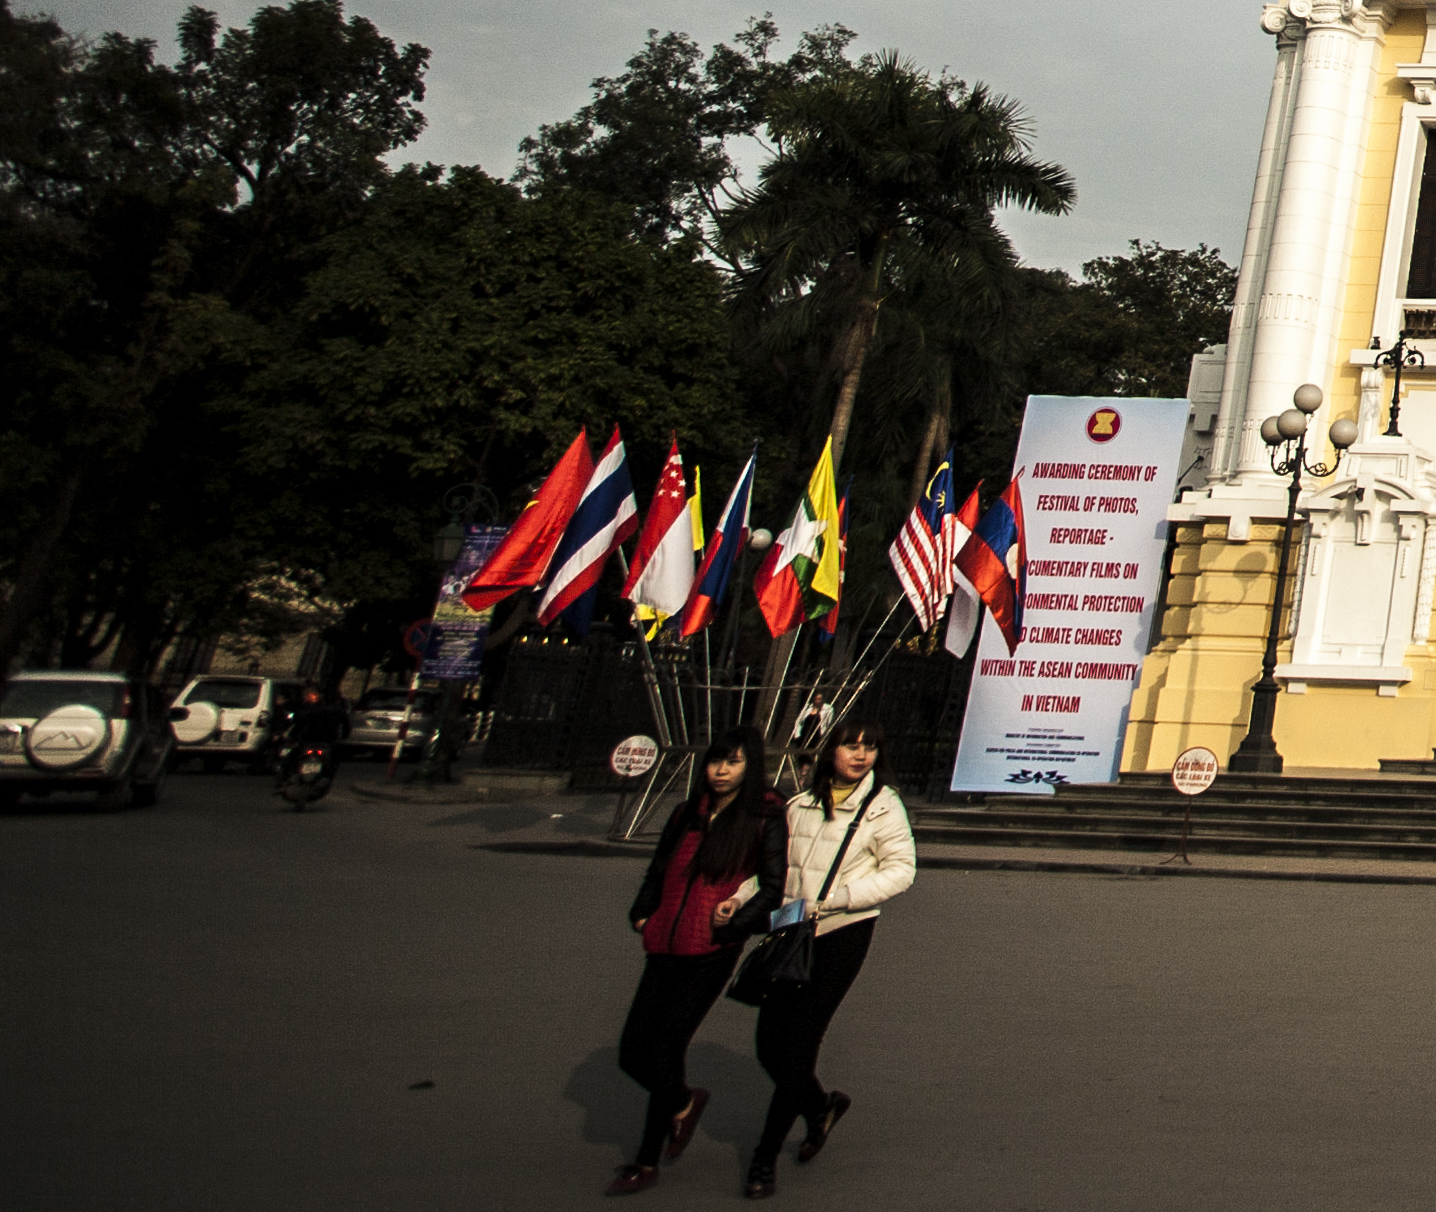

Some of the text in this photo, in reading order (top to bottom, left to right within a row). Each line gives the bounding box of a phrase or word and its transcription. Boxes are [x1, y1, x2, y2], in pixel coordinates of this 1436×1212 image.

[1032, 462, 1158, 482] AWARDING CEREMONY OF
[1036, 494, 1139, 516] FESTIVAL OF PHOTOS,
[1049, 527, 1108, 545] REPORTAGE
[1026, 559, 1139, 579] CUMENTARY FILMS ON
[1081, 594, 1145, 613] PROTECTION
[1029, 627, 1073, 645] CLIMATE
[1073, 628, 1123, 646] CHANGES
[979, 658, 1139, 681] WITHIN THE ASEAN COMMUNITY
[1020, 694, 1082, 713] IN VIETNAM
